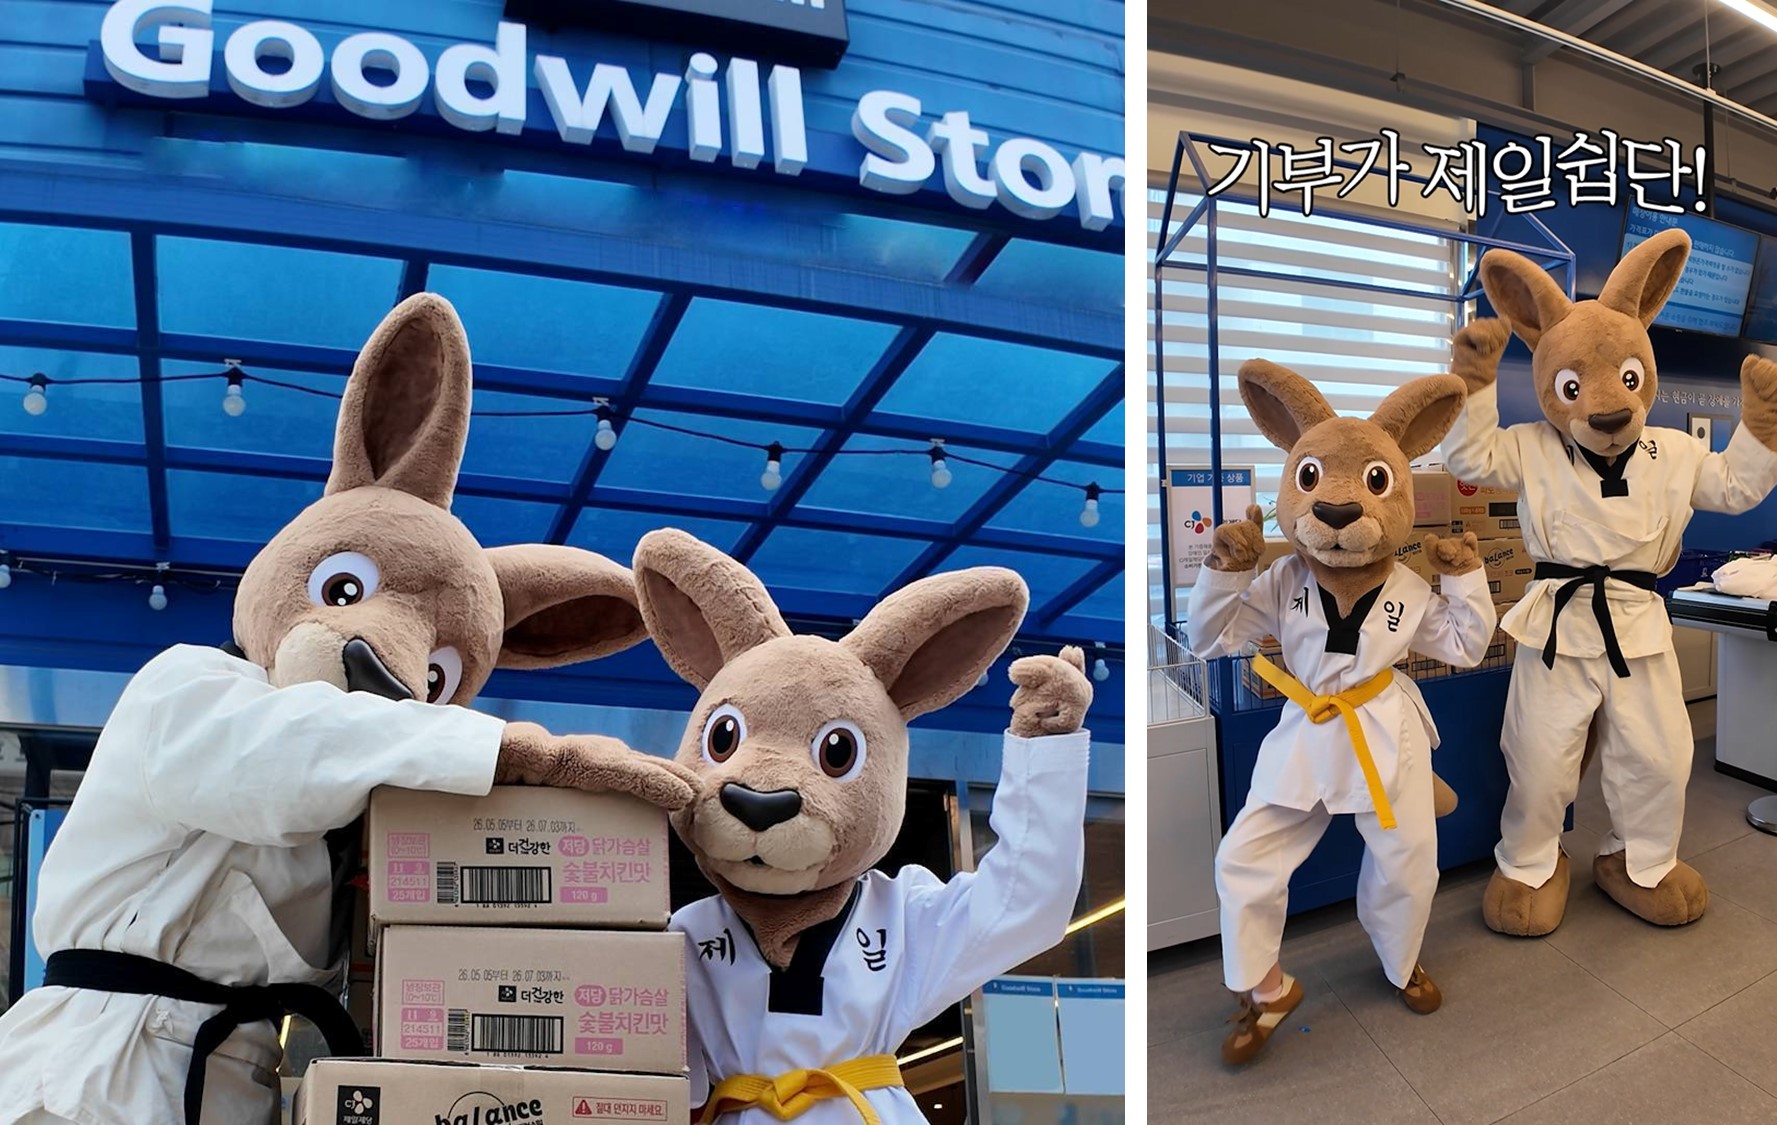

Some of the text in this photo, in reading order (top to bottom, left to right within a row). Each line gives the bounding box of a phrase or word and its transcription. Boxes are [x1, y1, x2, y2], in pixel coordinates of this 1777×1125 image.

[101, 0, 1125, 232] Goodwill Stor
[1186, 473, 1205, 484] 기업
[1226, 472, 1244, 484] 상품
[1184, 520, 1195, 529] CJ
[1384, 601, 1405, 632] 일
[508, 837, 551, 855] 더건강한
[592, 838, 651, 856] 닭가슴살
[562, 861, 651, 883] 숯불치킨맛
[571, 890, 588, 900] 120
[697, 928, 887, 971] 제 일
[521, 986, 564, 1004] 더건강한
[578, 987, 669, 1006] 저당 닭가슴살
[404, 1023, 441, 1033] 214511
[579, 1011, 669, 1034] 숯불치킨맛
[405, 1037, 439, 1049] 25개입
[587, 1041, 613, 1053] 120 g
[344, 1099, 356, 1110] CJ
[595, 1102, 612, 1115] 절대
[638, 1104, 662, 1116] 마세요
